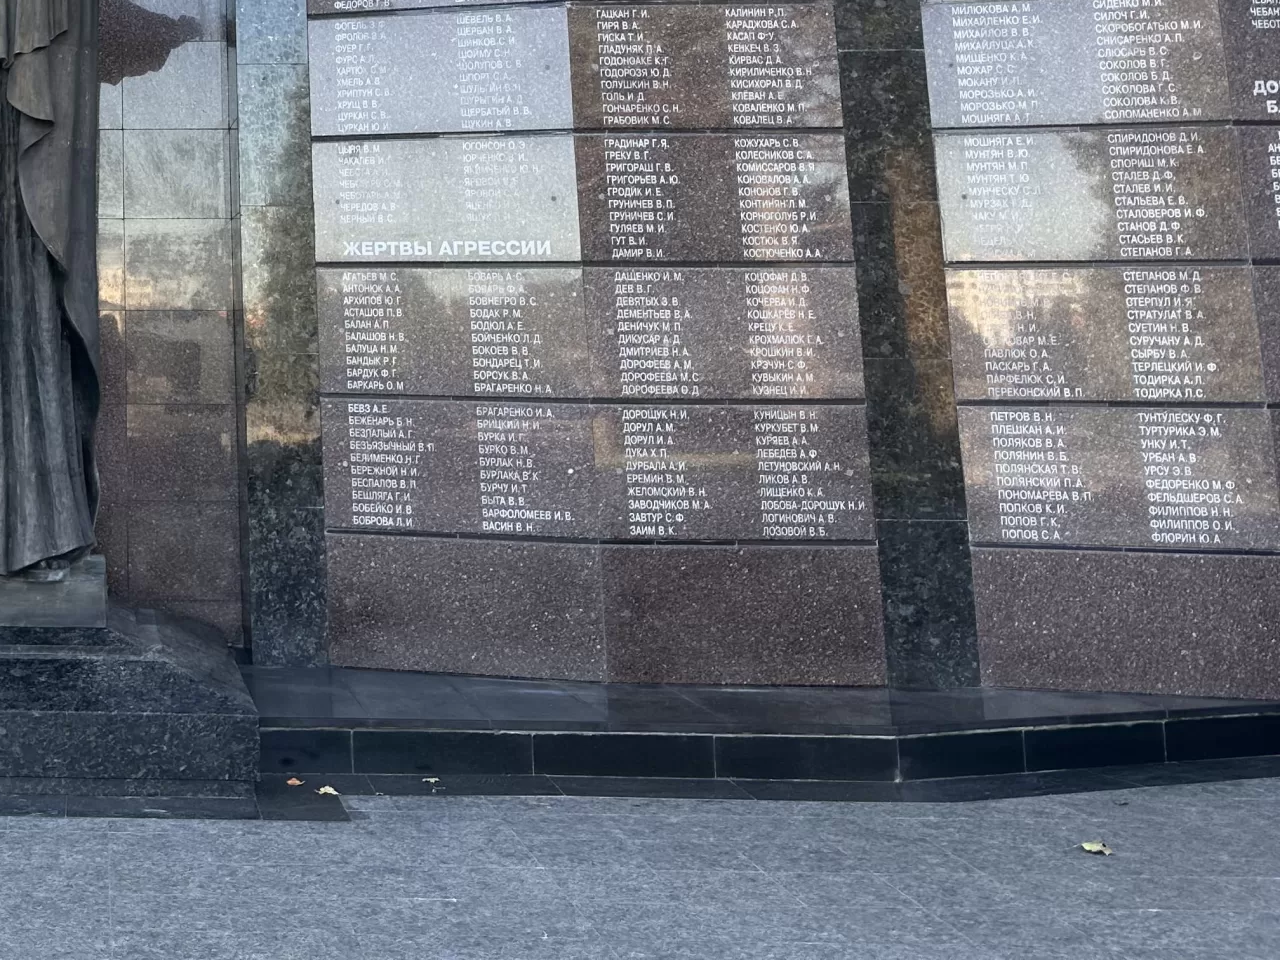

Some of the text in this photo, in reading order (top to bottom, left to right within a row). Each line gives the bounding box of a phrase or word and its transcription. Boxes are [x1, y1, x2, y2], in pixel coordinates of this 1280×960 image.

[726, 19, 779, 29] КАРАДЖОВА
[600, 68, 648, 78] ГОДОРОЗЯ
[602, 103, 660, 113] ГОНЧАРЕНКО
[732, 103, 785, 113] КОВАЛЕНКО
[603, 115, 649, 125] ГРАБОВИК
[734, 138, 780, 148] КОЖУХАРЬ
[1107, 133, 1177, 143] СПИРИДОНОВ
[604, 139, 649, 148] ГРАДИНАР
[605, 151, 632, 161] ГРЕКУ
[735, 150, 794, 160] КОЛЕСНИКОВ
[606, 163, 653, 173] ГРИГОРАШ
[606, 175, 657, 185] ГРИГОРЬЕВ
[1111, 171, 1149, 181] СТАЛЕВ
[607, 187, 642, 197] ГРОДИК
[608, 199, 653, 209] ГРУНИЧЕВ
[740, 211, 798, 221] КОРНОГОЛУБ
[1116, 208, 1181, 218] СТАЛОВЕРОВ
[610, 223, 644, 233] ГУЛЯЕВ
[343, 240, 552, 256] ЖЕРТВЫ АГРЕССИИ
[612, 248, 643, 258] ДАМИР
[744, 248, 803, 258] КОСТЮЧЕНКО
[469, 296, 517, 306] БОВНЕГРО
[470, 309, 500, 318] БОДАК
[1135, 388, 1182, 398] ТОДИРКА
[348, 404, 371, 413] БЕВЗ
[476, 407, 533, 417] БРАГАРЕНКО
[622, 410, 668, 420] ДОРОЩУК
[990, 412, 1030, 422] ПЕТРОВ
[1142, 453, 1175, 463] УРБАН
[1145, 480, 1210, 490] ФЕДОРЕНКО
[627, 487, 686, 497] ЖЕЛОМСКИЙ
[998, 491, 1069, 501] ПОНОМАРЕВА
[482, 510, 552, 519] ВАРФОЛОМЕЕВ
[1148, 506, 1208, 516] ФИЛИППОВ
[353, 517, 394, 526] БОБРОВА
[629, 513, 663, 523] ЗАВТУР
[1001, 517, 1037, 526] ПОПОВ
[483, 521, 513, 531] ВАСИН
[630, 526, 656, 536] ЗАИМ
[1151, 534, 1196, 544] ФЛОРИН
